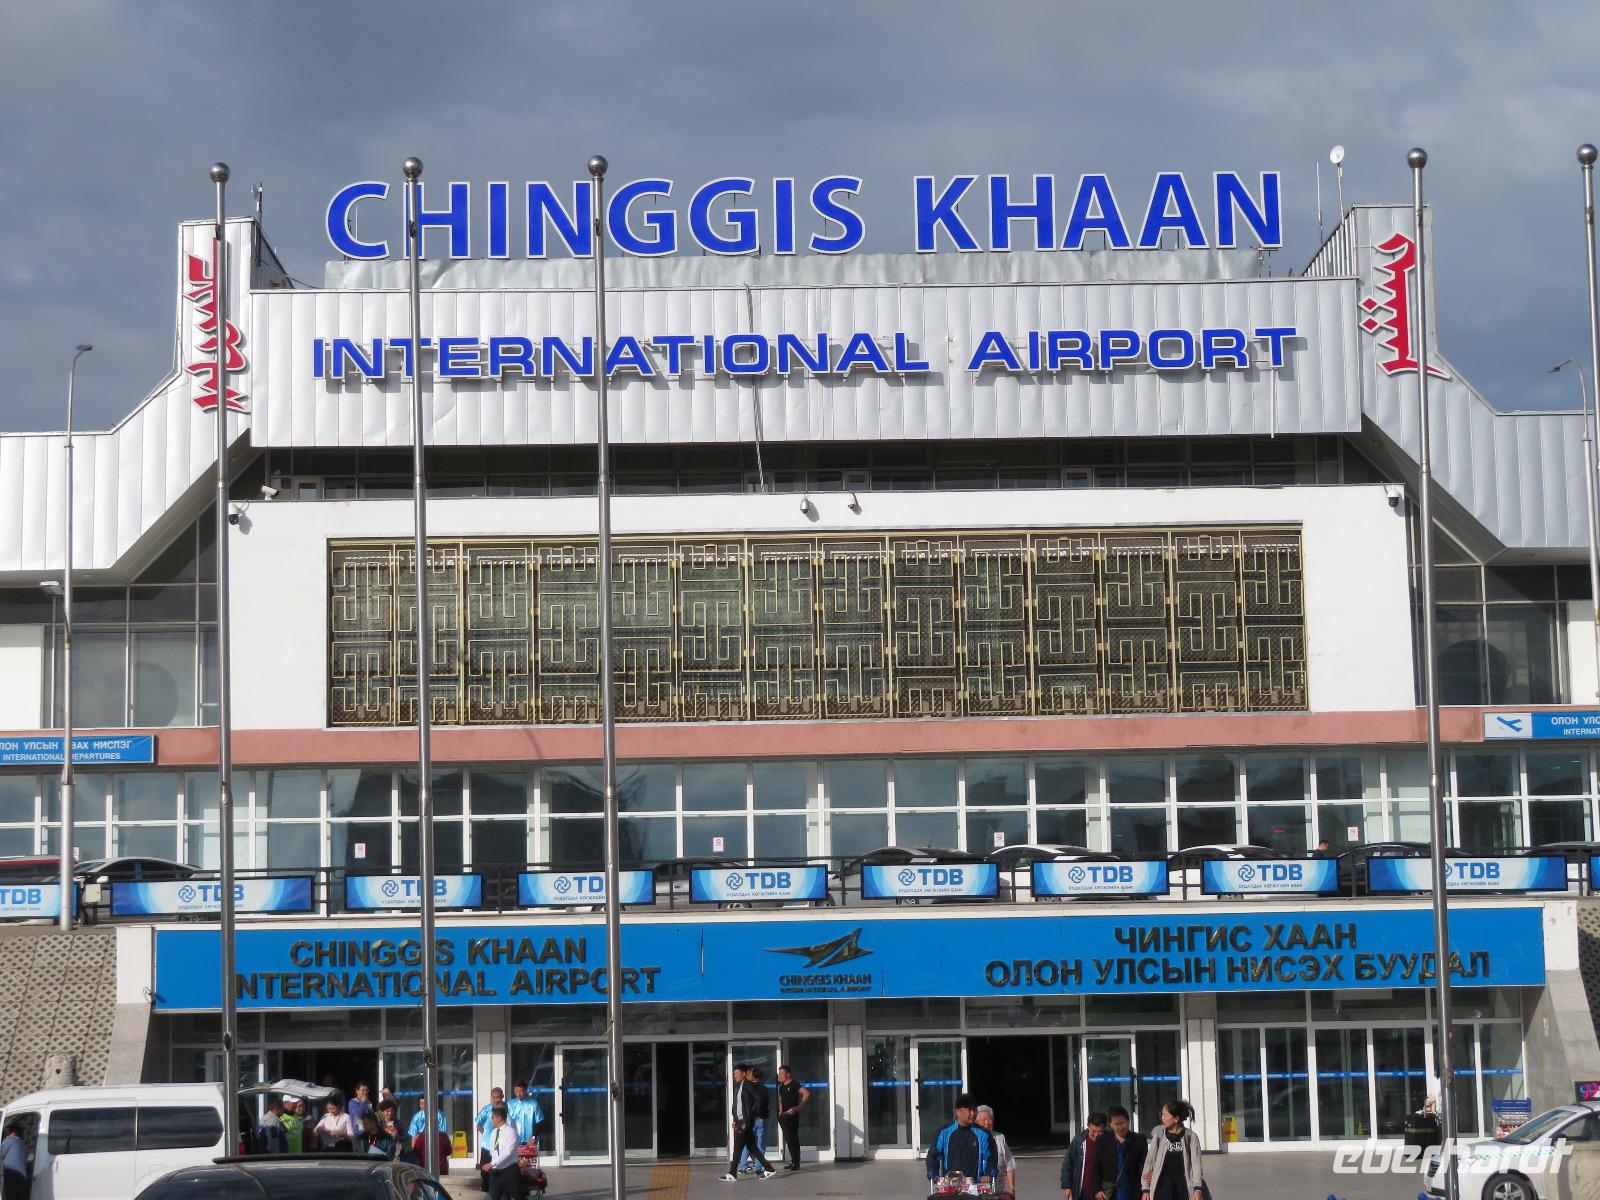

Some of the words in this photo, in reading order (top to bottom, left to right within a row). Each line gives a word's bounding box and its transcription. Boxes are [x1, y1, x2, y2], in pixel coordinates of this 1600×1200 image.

[324, 175, 866, 260] CHINGGIS
[913, 171, 1283, 252] KHAAN
[312, 331, 931, 379] INTERNATIONAL
[966, 326, 1297, 371] AIRPORT
[24, 741, 58, 750] УЛСЫН
[65, 740, 89, 750] ВАХ
[94, 740, 132, 750] НИСЛЭГ
[918, 868, 963, 886] TDB
[1087, 866, 1133, 882] TDB
[1257, 864, 1303, 881] TDB
[1454, 862, 1500, 878] TDB
[573, 876, 604, 893] TD
[745, 871, 791, 889] TDB
[1114, 925, 1252, 953] ЧИНГИС
[1263, 923, 1357, 950] ХААН
[290, 939, 454, 968] CHINGGS
[467, 936, 587, 965] KHAAN
[985, 958, 1083, 987] ОЛОН
[1093, 956, 1216, 985] УЛСЫН
[1227, 953, 1344, 983] НИСЭХ
[1354, 950, 1489, 985] БУУДАЛ
[235, 969, 496, 1000] NTERNATIONAL
[510, 967, 661, 996] AIRPORT
[779, 974, 831, 986] CHINGGIS
[833, 973, 872, 985] KHAAN
